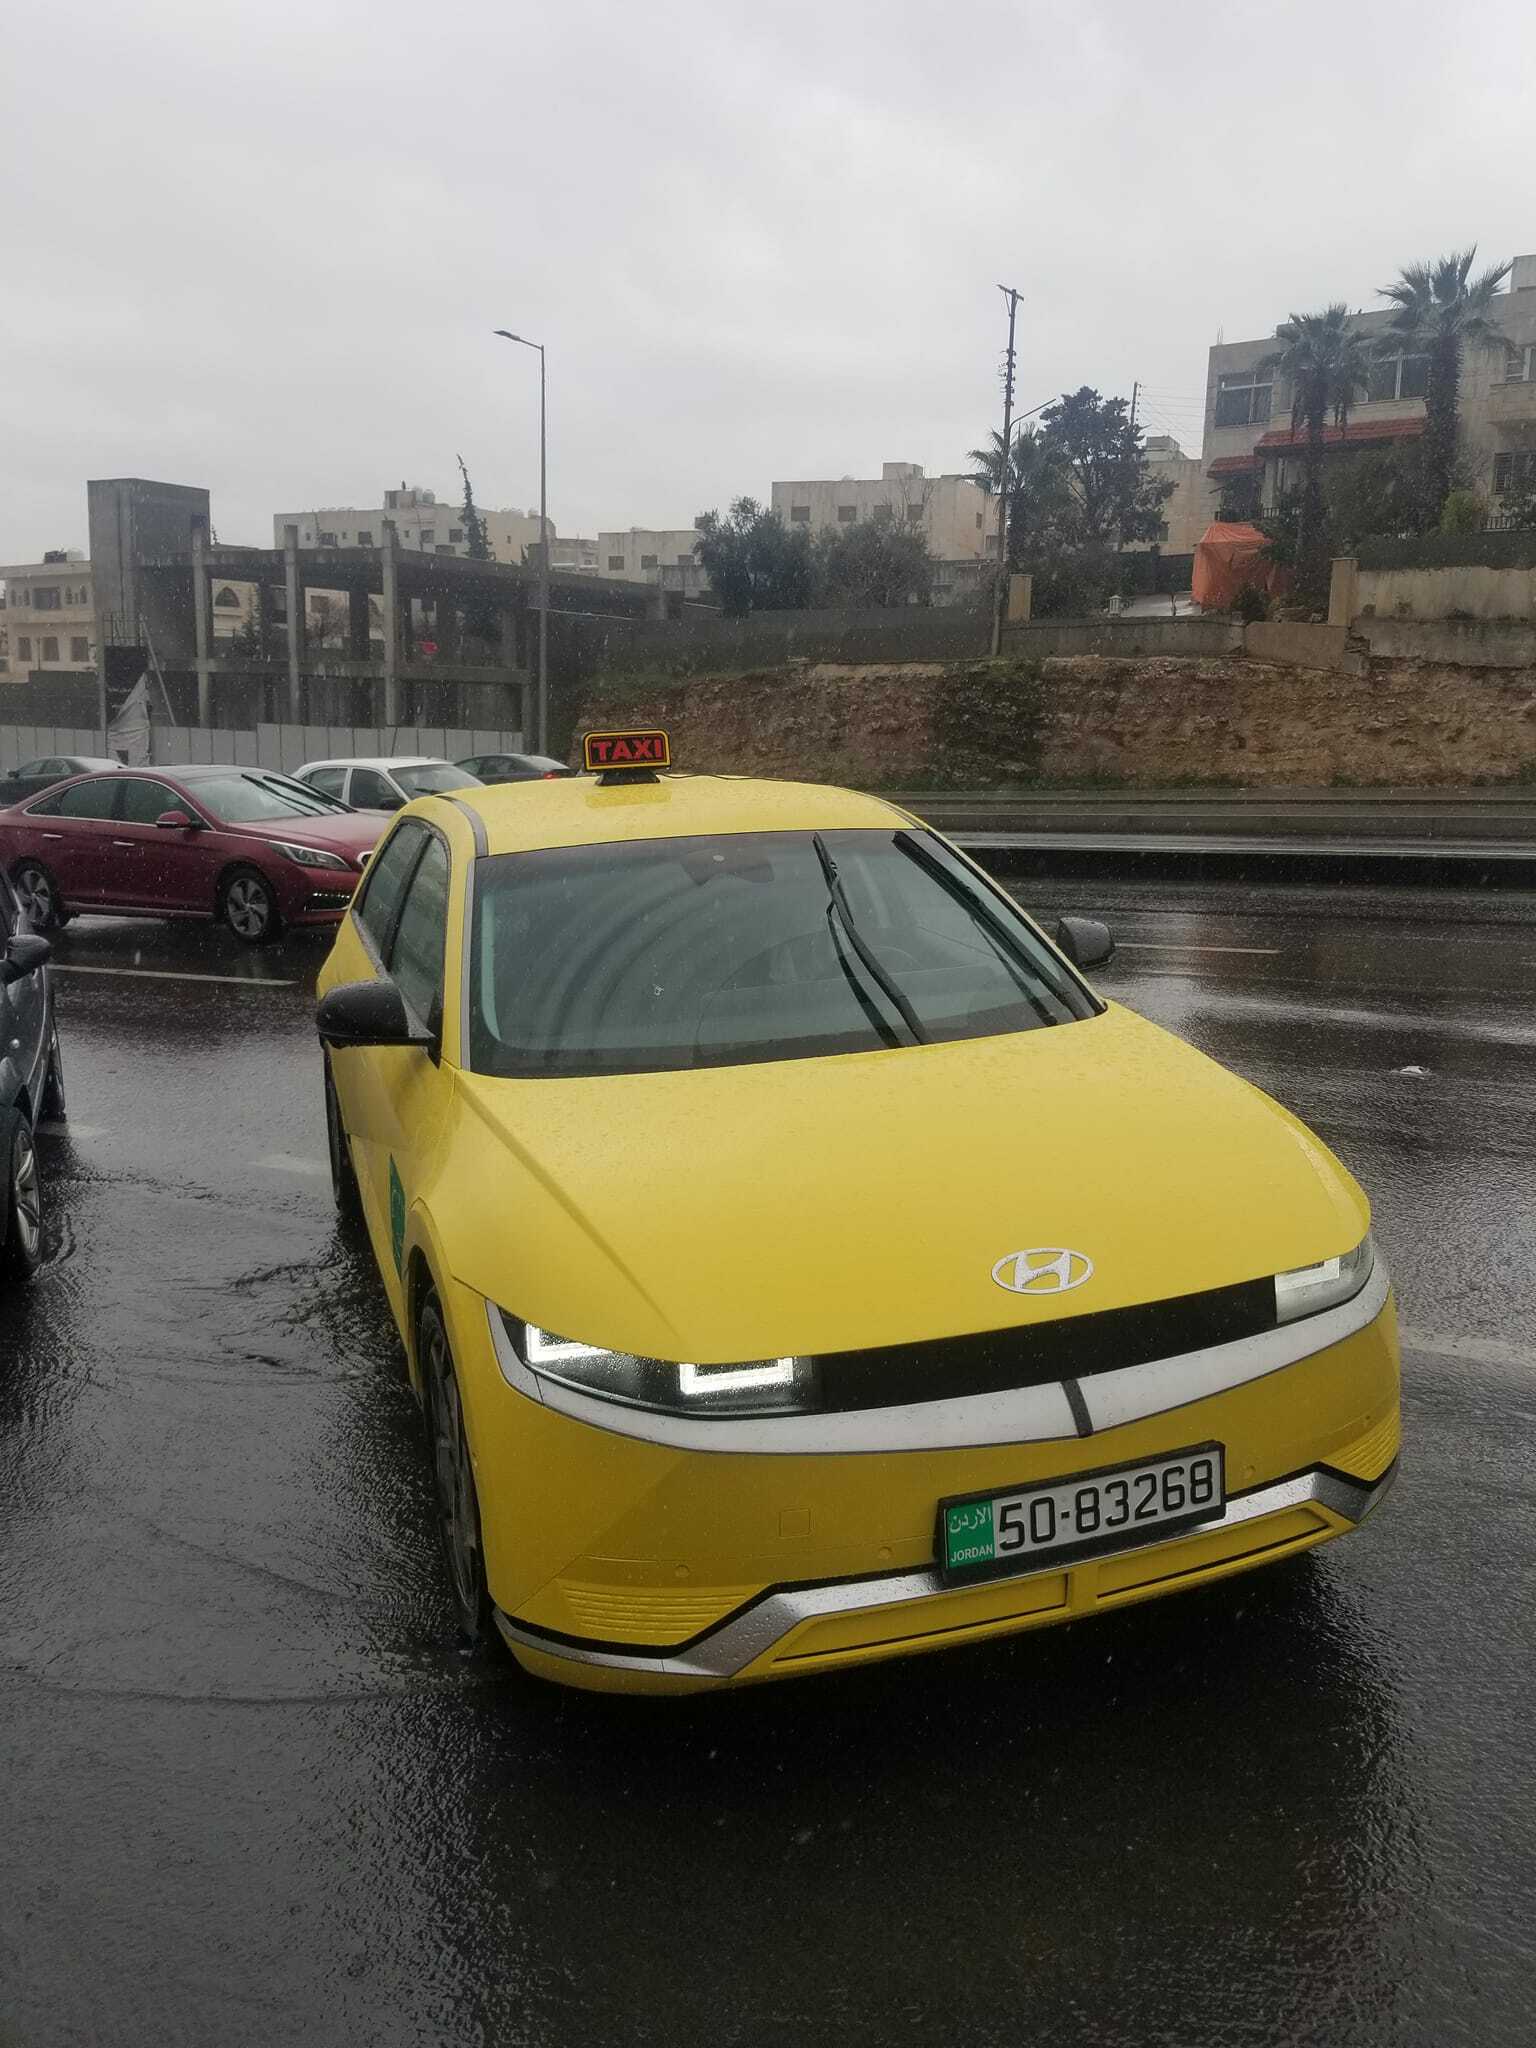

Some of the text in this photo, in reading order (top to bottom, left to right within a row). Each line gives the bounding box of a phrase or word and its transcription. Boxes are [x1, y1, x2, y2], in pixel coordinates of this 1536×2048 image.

[592, 738, 663, 761] TAXI
[999, 1459, 1213, 1551] 50-83268
[951, 1543, 993, 1562] JORDAN
